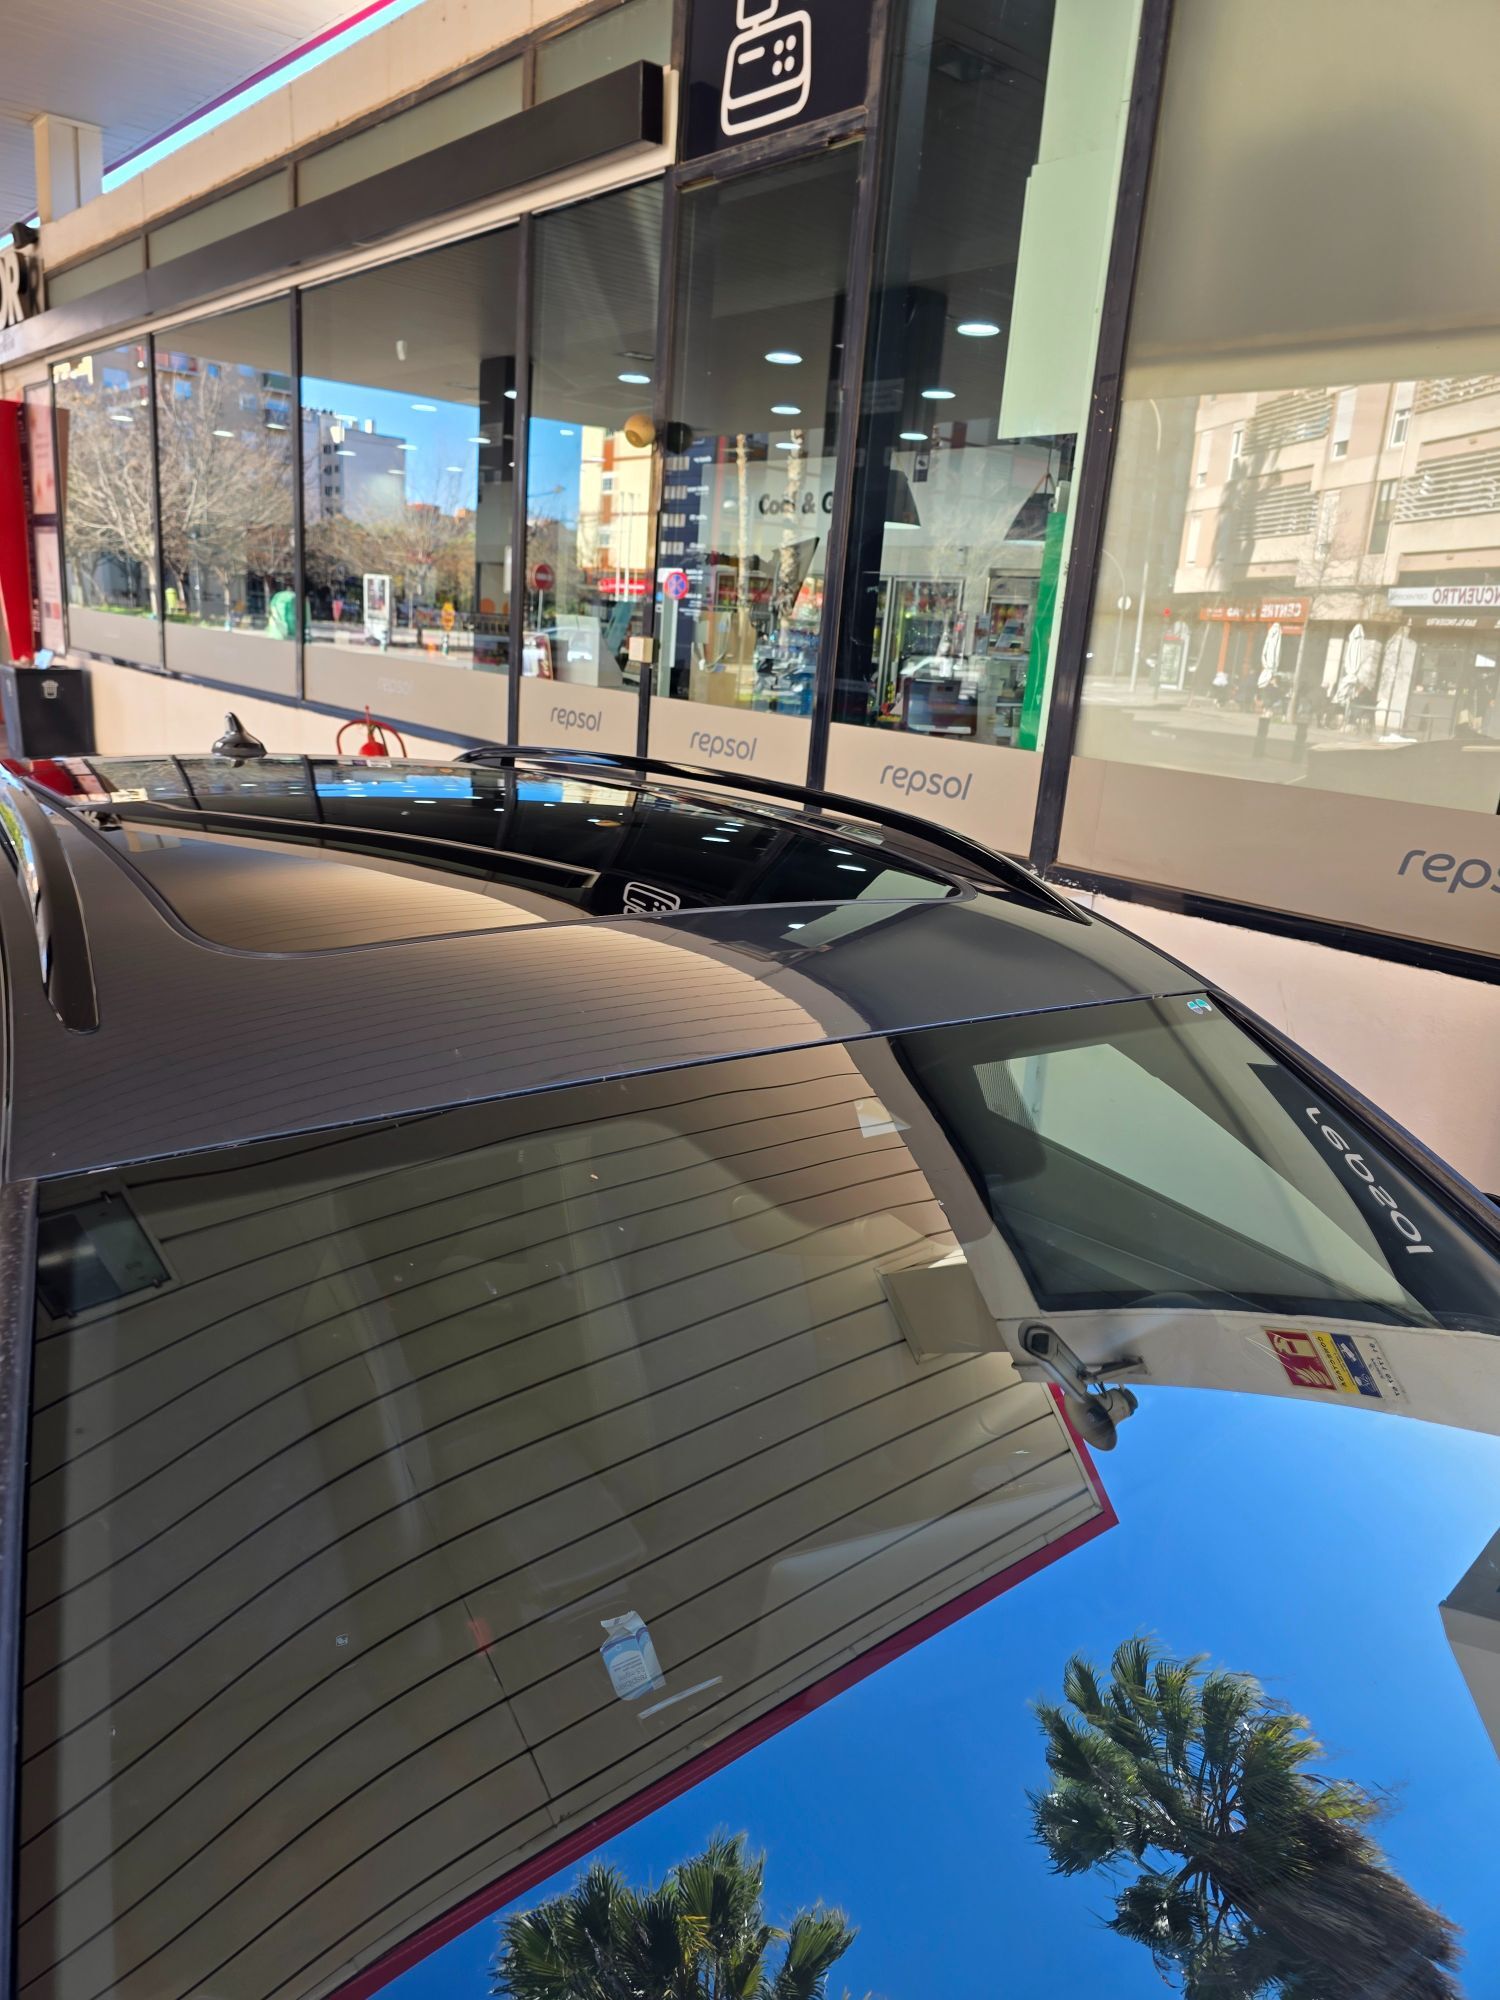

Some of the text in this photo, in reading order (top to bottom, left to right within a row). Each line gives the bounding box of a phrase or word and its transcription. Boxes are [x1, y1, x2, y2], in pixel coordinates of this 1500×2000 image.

[802, 491, 816, 515] &
[550, 706, 602, 732] repsol
[690, 731, 757, 761] repsol
[880, 765, 973, 800] repsol
